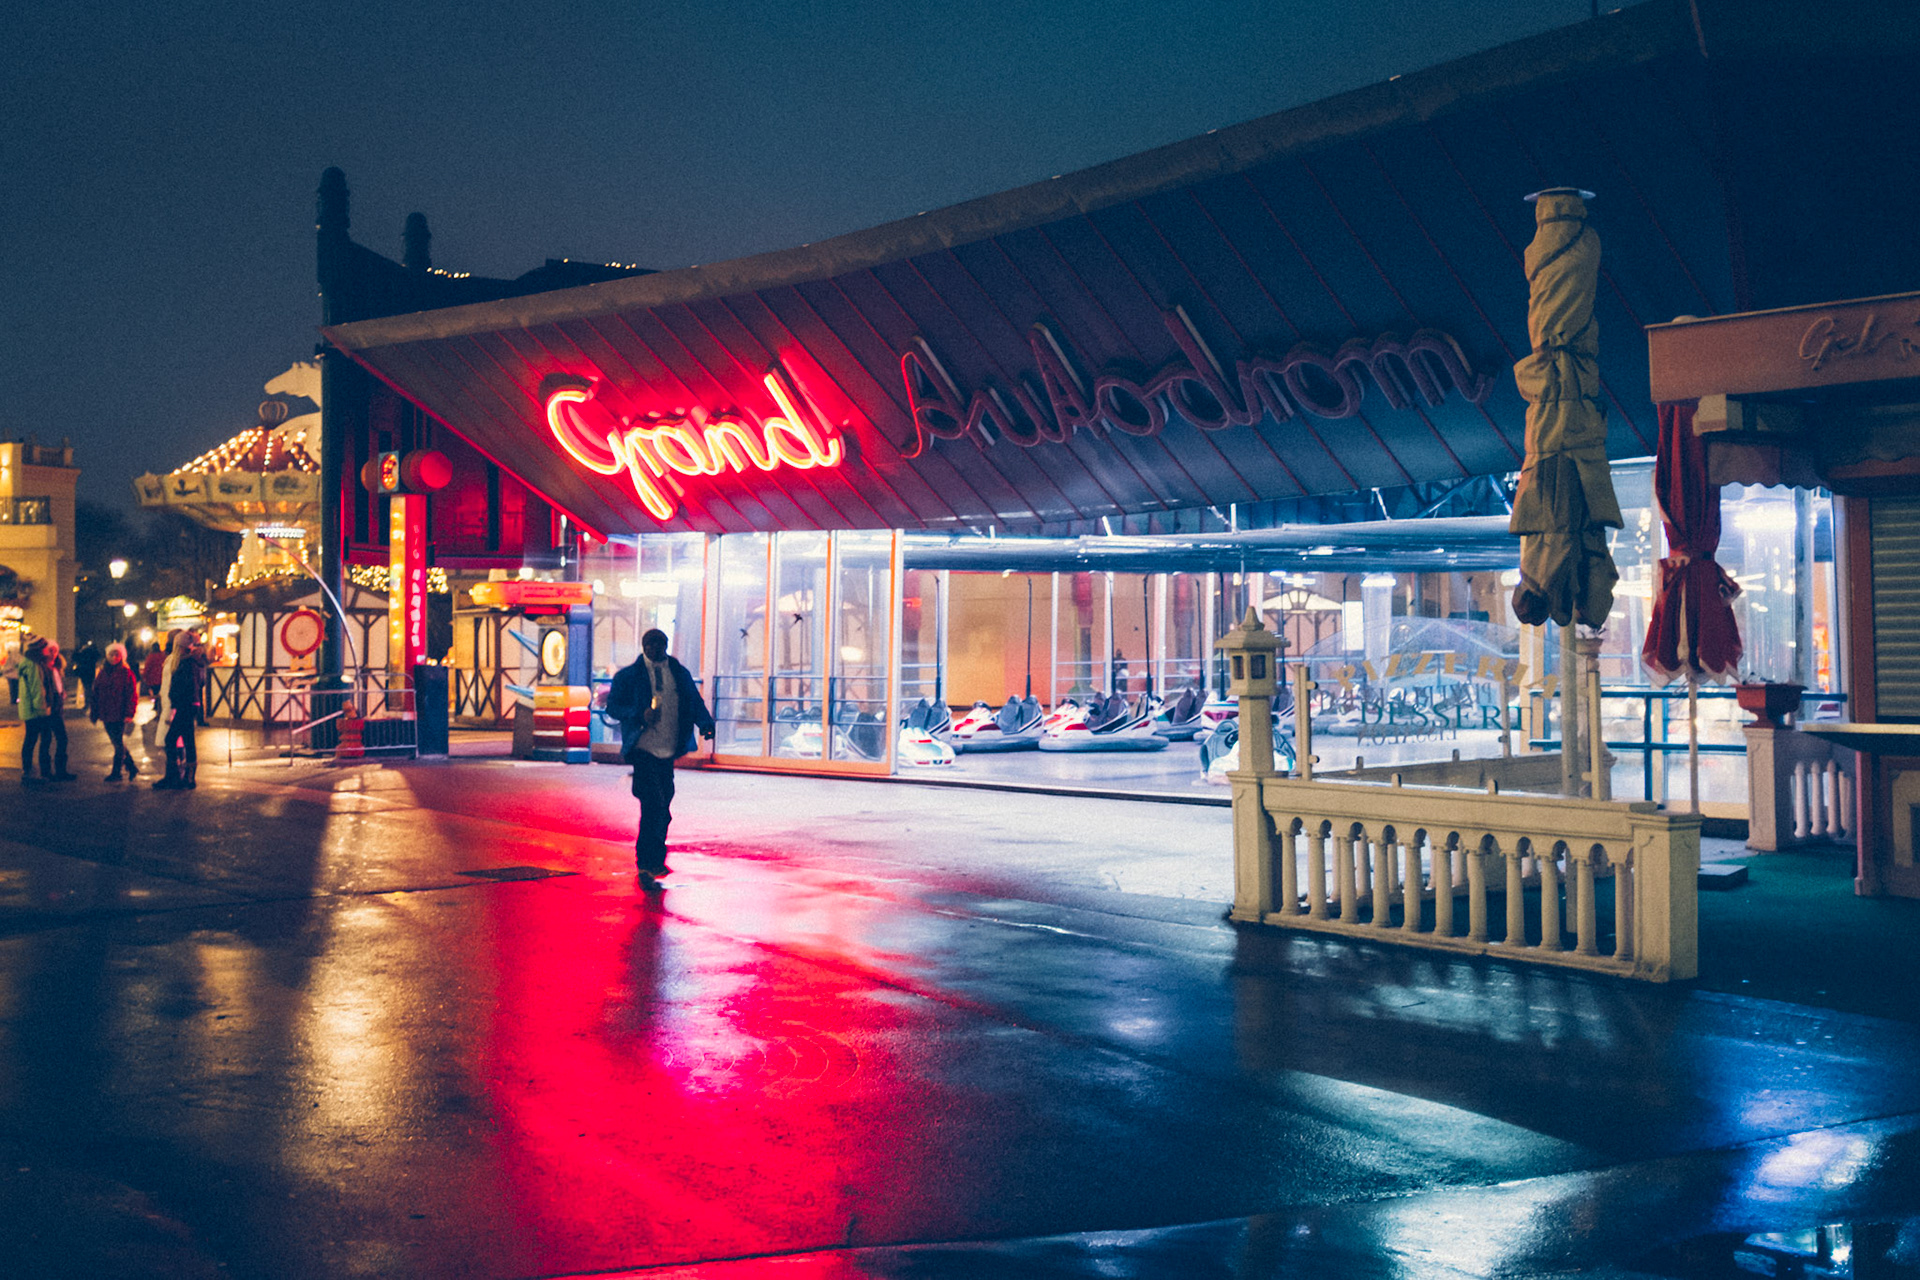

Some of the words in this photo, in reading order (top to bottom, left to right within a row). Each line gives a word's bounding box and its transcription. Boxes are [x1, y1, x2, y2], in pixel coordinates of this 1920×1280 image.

[543, 369, 845, 521] Grand
[1332, 652, 1561, 700] PIZZERIA
[1359, 700, 1533, 732] DESSERT
